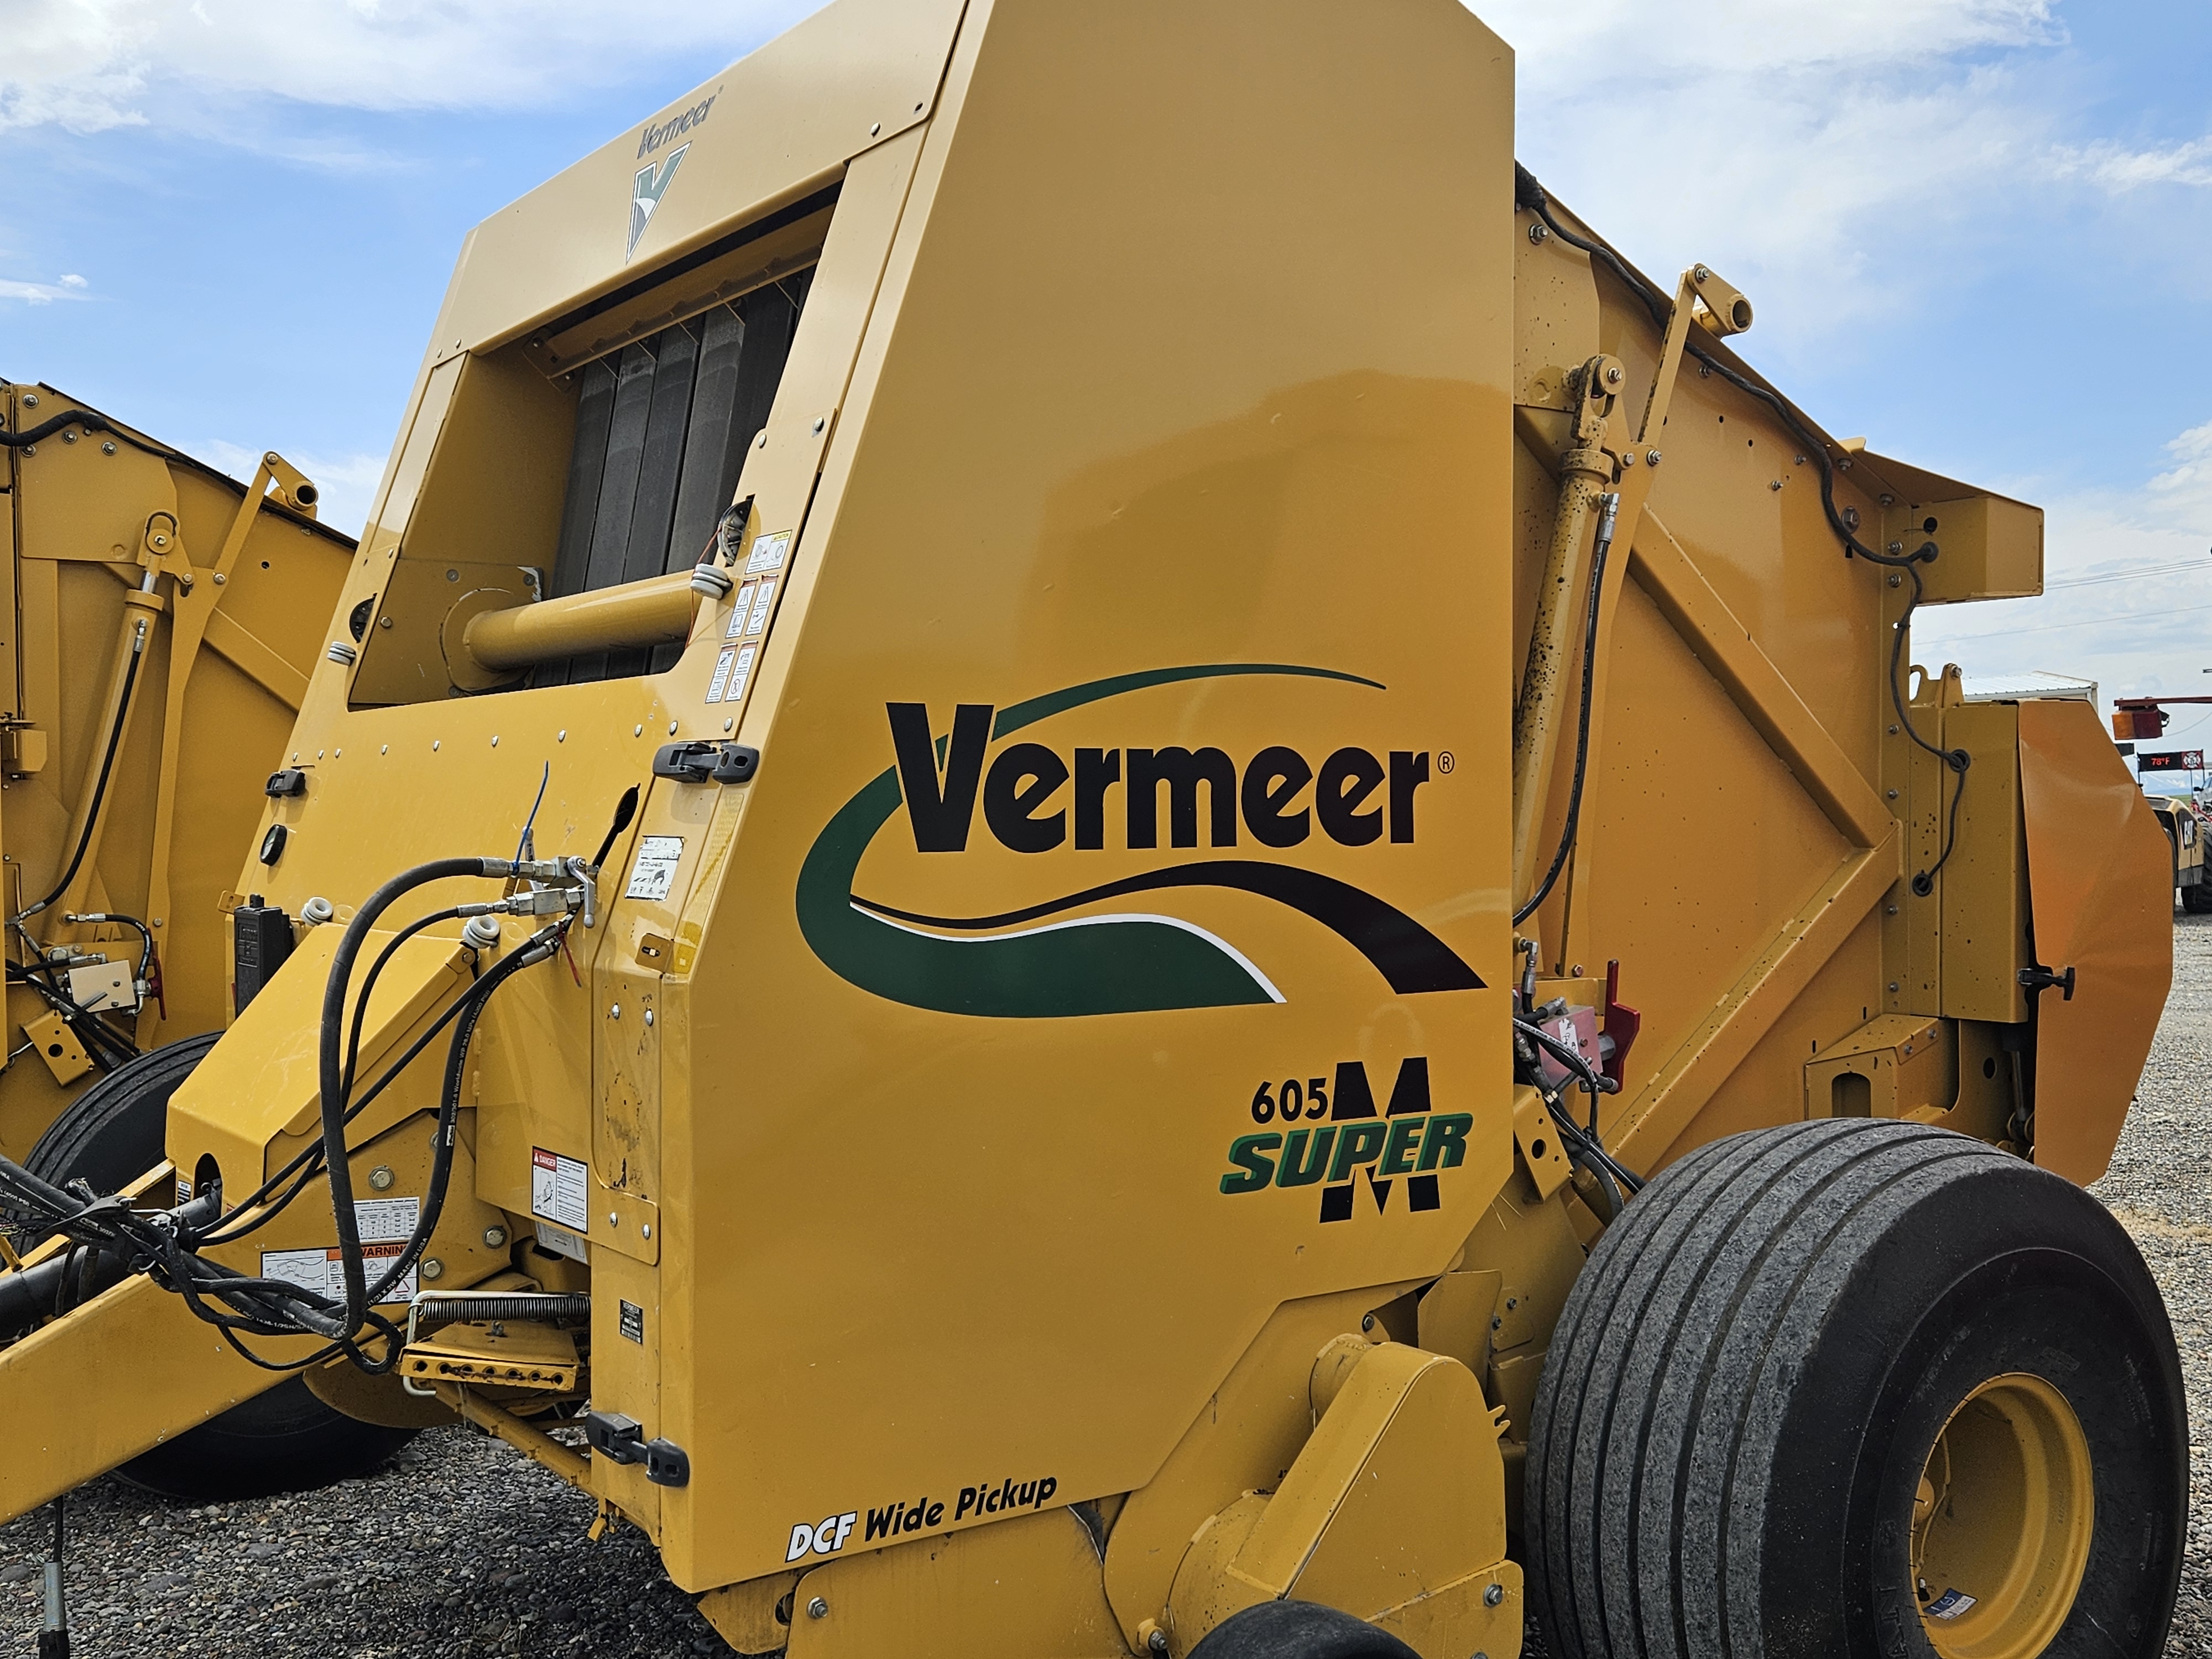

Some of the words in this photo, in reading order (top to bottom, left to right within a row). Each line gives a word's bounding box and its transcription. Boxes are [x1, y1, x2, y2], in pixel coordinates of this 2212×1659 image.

[637, 94, 716, 159] Vermeer
[885, 702, 1429, 853] Vermeer
[1251, 1078, 1328, 1124] 605
[1219, 1113, 1473, 1194] SUPER
[398, 1260, 414, 1279] MADE
[412, 1251, 419, 1260] IN
[417, 1238, 428, 1252] USA
[785, 1511, 858, 1563] DCF
[864, 1496, 945, 1542] Wide
[954, 1477, 1057, 1521] Pickup
